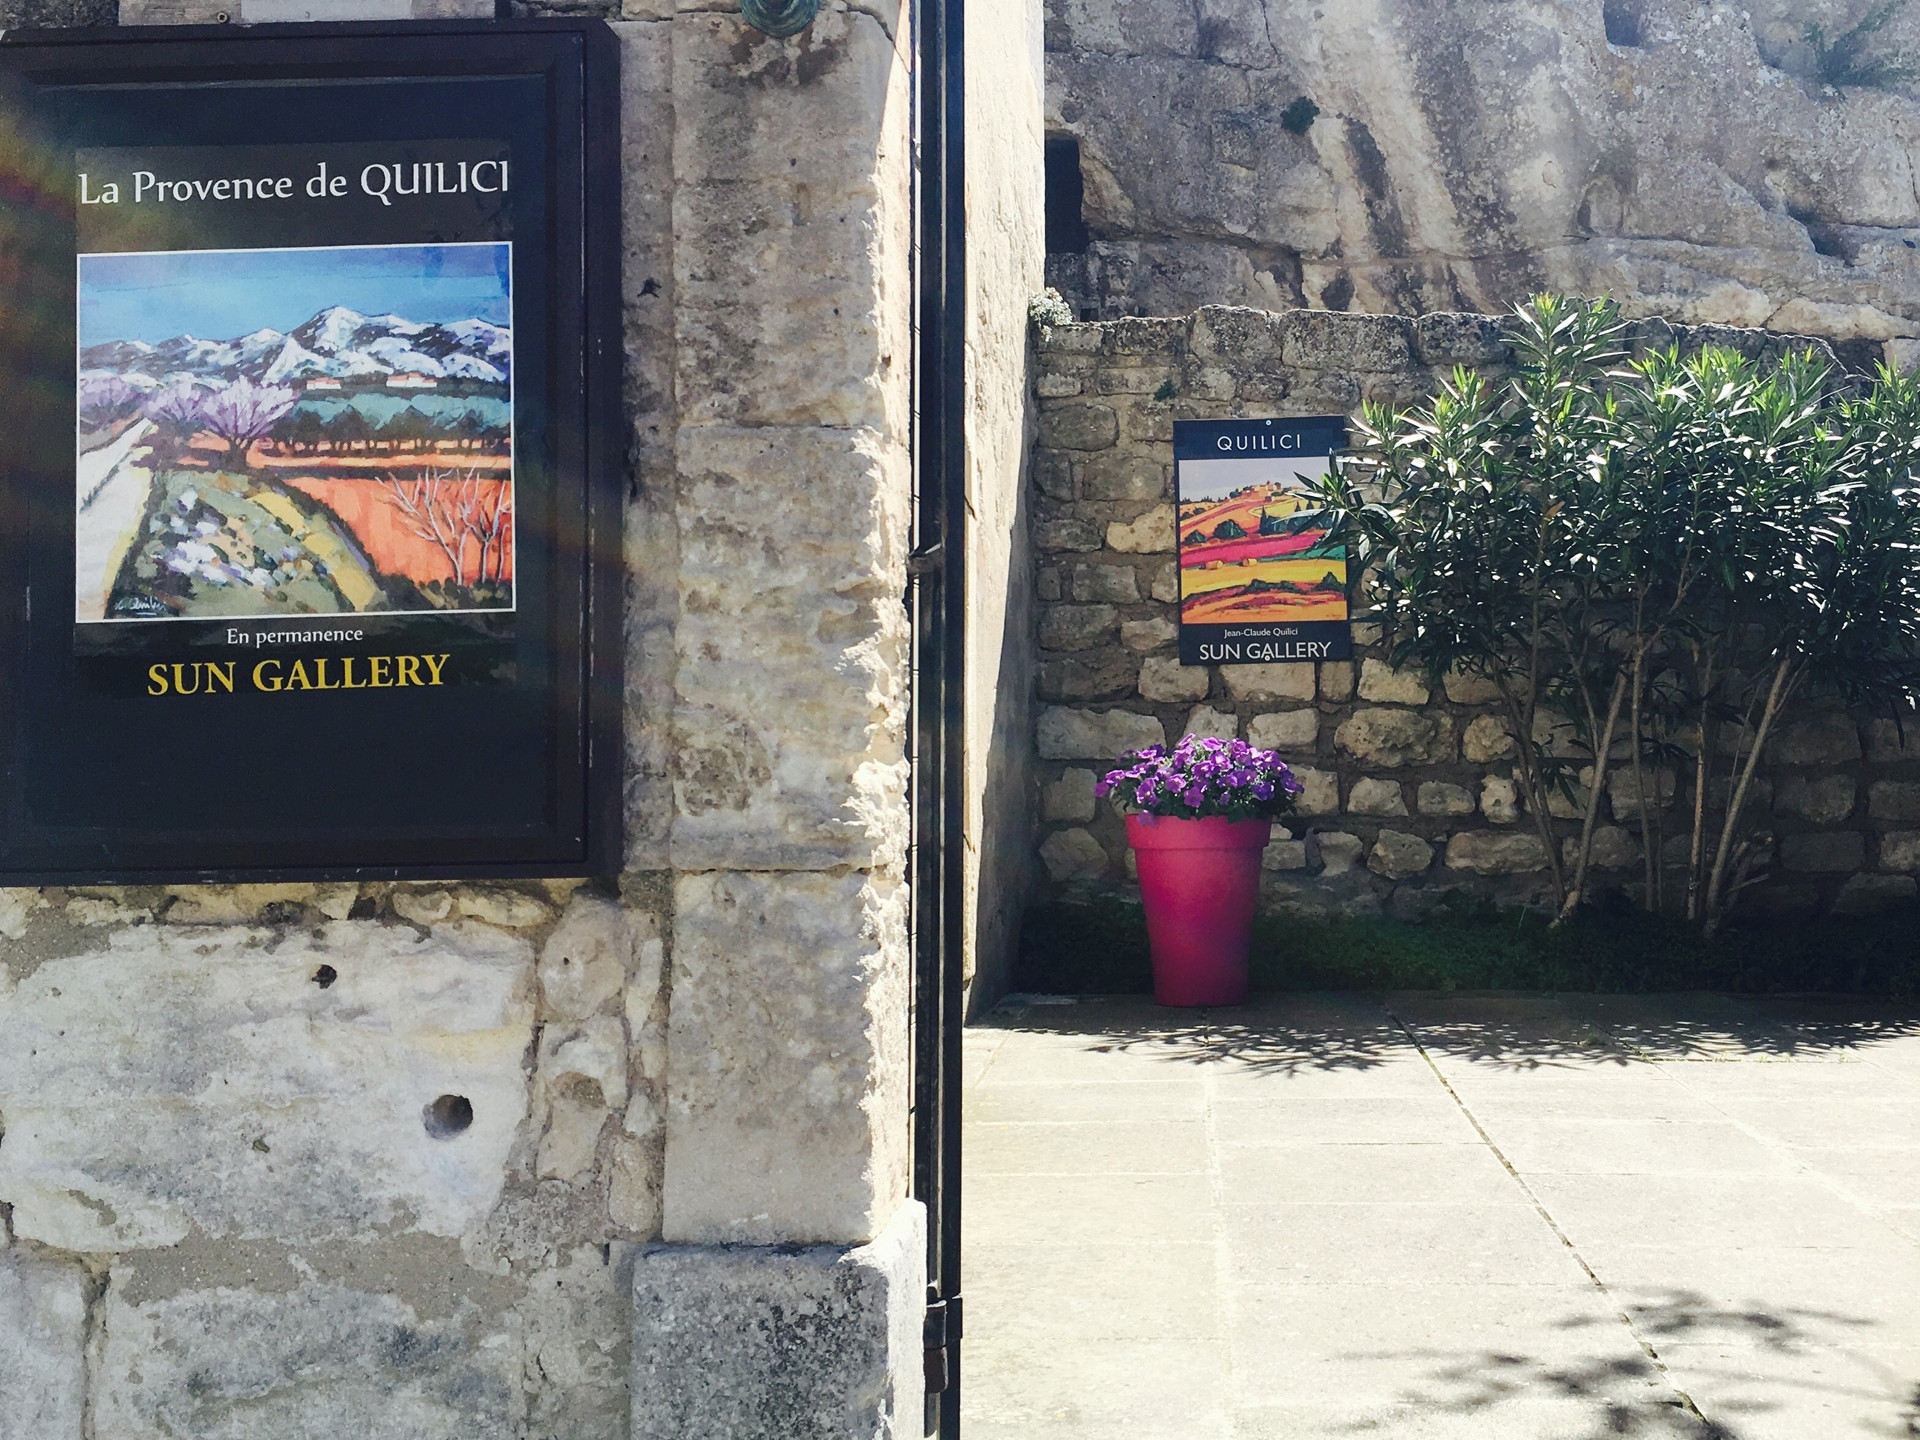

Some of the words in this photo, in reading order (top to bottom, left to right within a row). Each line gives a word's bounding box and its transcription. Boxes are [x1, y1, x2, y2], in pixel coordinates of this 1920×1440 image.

[79, 174, 118, 204] La
[133, 172, 293, 203] Provence
[306, 162, 347, 198] de
[360, 160, 509, 206] QUILICI
[1217, 434, 1302, 451] QUILICI
[226, 628, 250, 645] En
[255, 627, 364, 649] permanence
[1223, 628, 1271, 639] Jean-Claude
[1272, 627, 1299, 637] Quilici
[1199, 644, 1240, 661] SUN
[1246, 641, 1332, 660] GALLERY
[147, 662, 236, 696] SUN
[252, 653, 451, 692] GALLERY
